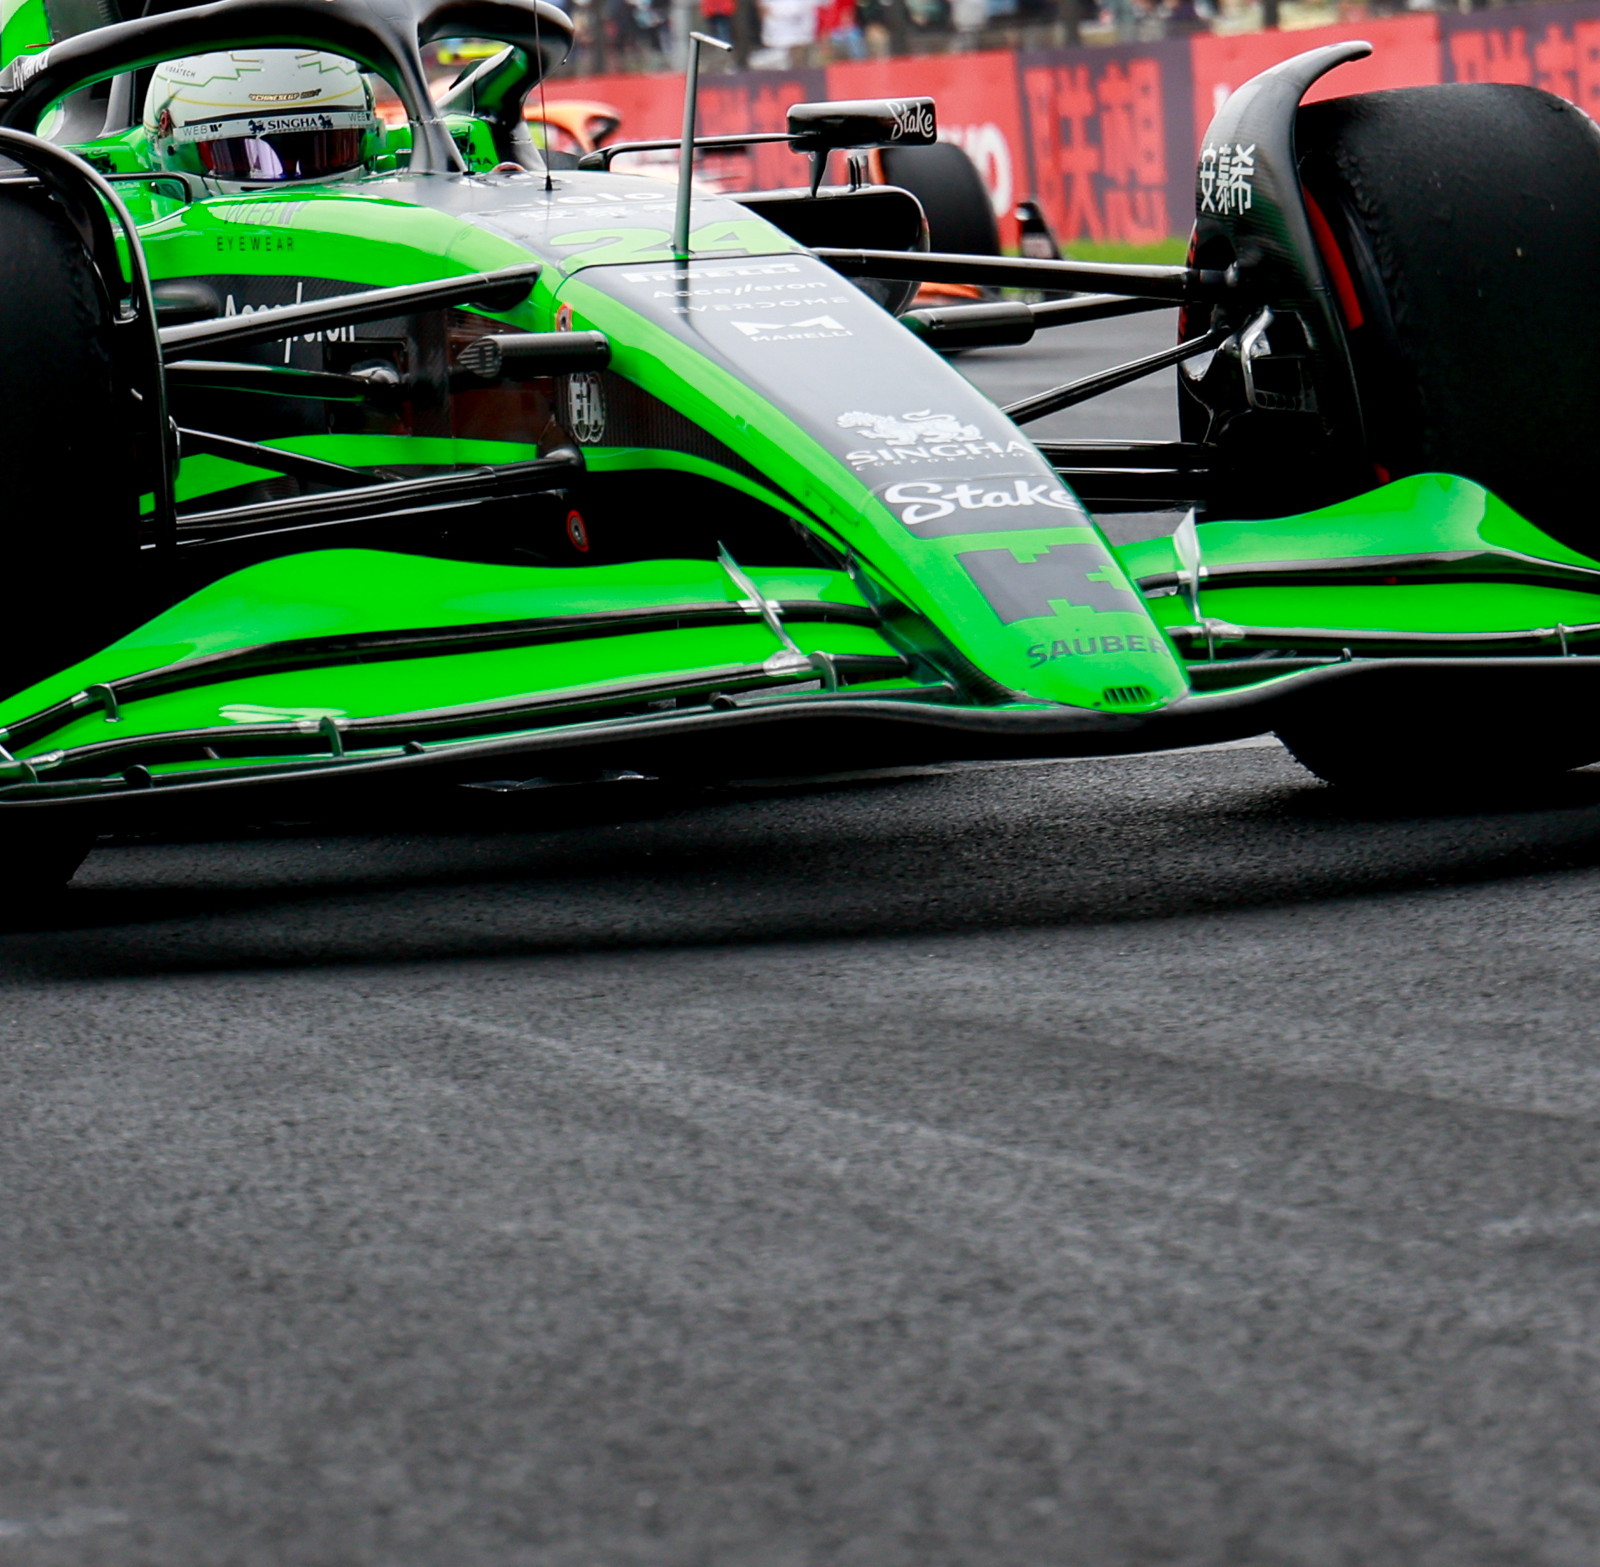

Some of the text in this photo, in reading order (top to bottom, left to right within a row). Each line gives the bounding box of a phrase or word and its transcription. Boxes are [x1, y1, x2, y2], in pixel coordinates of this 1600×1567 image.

[183, 125, 208, 136] WEB
[267, 117, 318, 130] SINGHA
[885, 101, 935, 141] Stake
[217, 236, 295, 252] EYEWEAR
[550, 220, 802, 271] 24
[750, 330, 854, 342] MARELLI
[845, 441, 1034, 467] SINGHA
[854, 451, 1040, 472] CORPORATIO
[884, 480, 1090, 525] Stake
[1026, 633, 1172, 669] SAUBER
